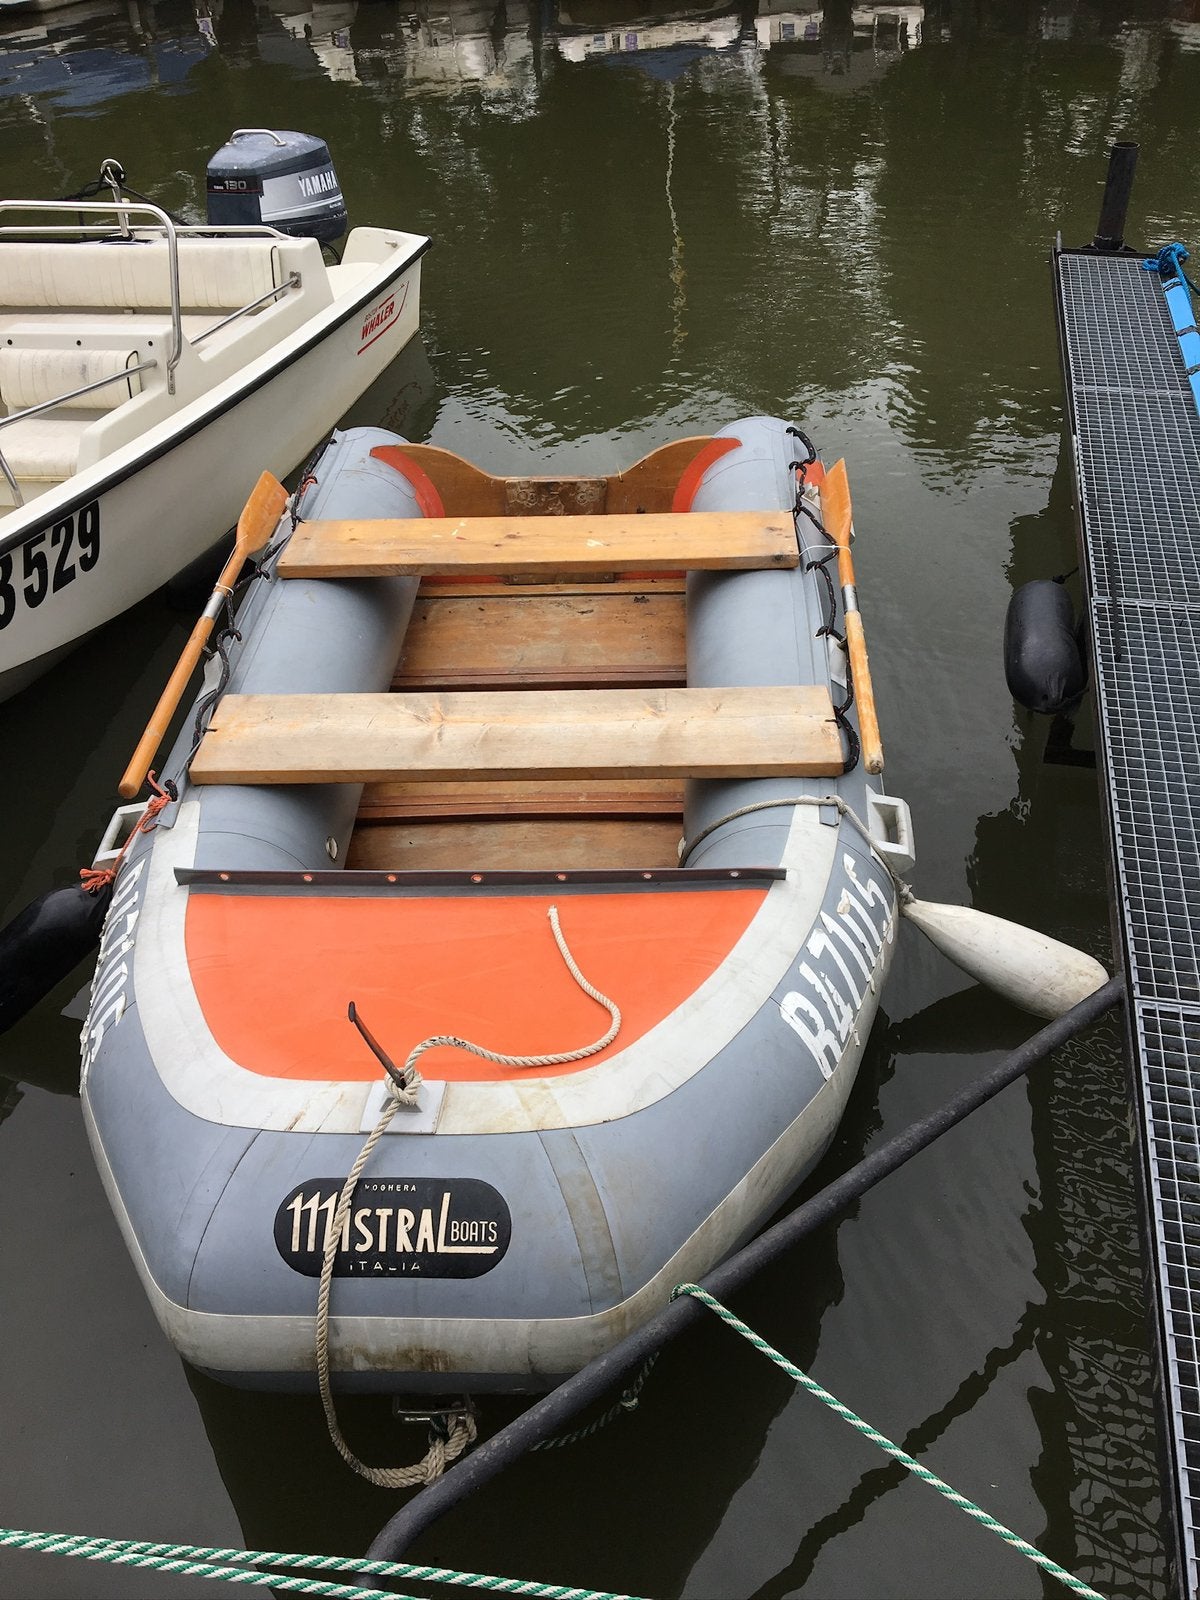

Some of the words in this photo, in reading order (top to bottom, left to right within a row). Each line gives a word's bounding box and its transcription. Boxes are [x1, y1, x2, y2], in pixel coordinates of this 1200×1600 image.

[298, 170, 338, 197] YAMAHA
[361, 300, 395, 341] WHALER
[450, 1220, 498, 1243] BOATS
